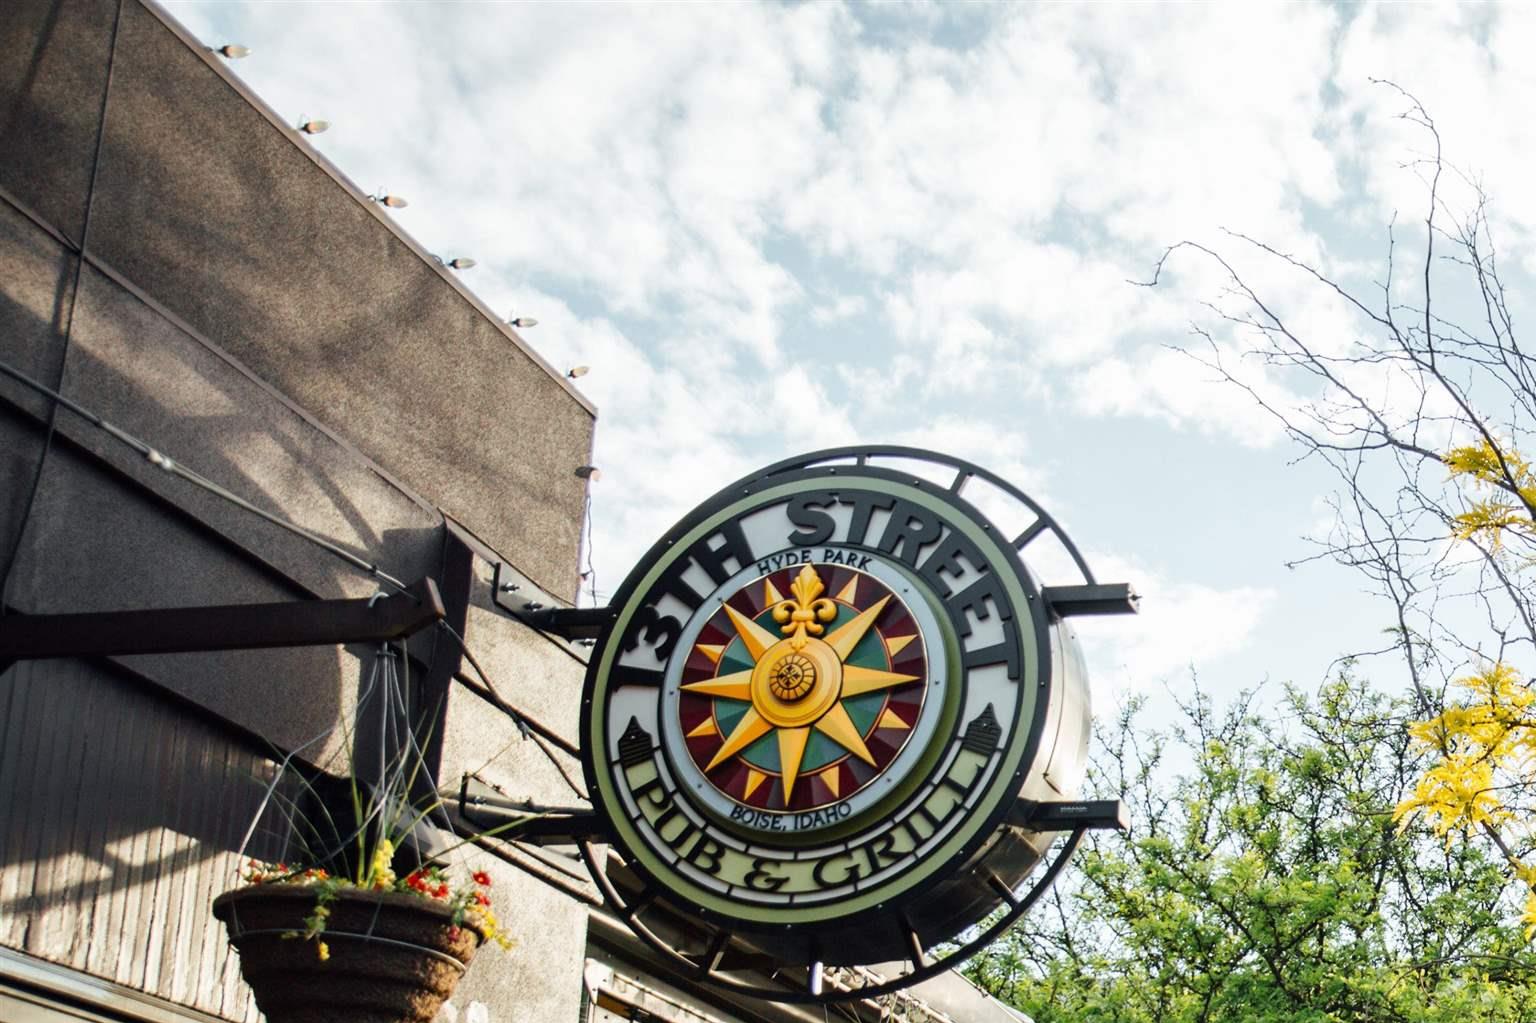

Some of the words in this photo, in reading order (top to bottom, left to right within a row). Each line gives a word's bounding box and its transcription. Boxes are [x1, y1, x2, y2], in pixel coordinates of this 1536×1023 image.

[611, 516, 757, 692] 13TH
[786, 490, 1019, 680] STREET
[757, 549, 813, 576] HYDE
[823, 549, 873, 572] PARK
[631, 776, 722, 876] PUB
[743, 859, 790, 891] &
[811, 763, 985, 890] GRILL
[729, 805, 787, 832] BOISE,
[793, 801, 852, 830] IDAHO
